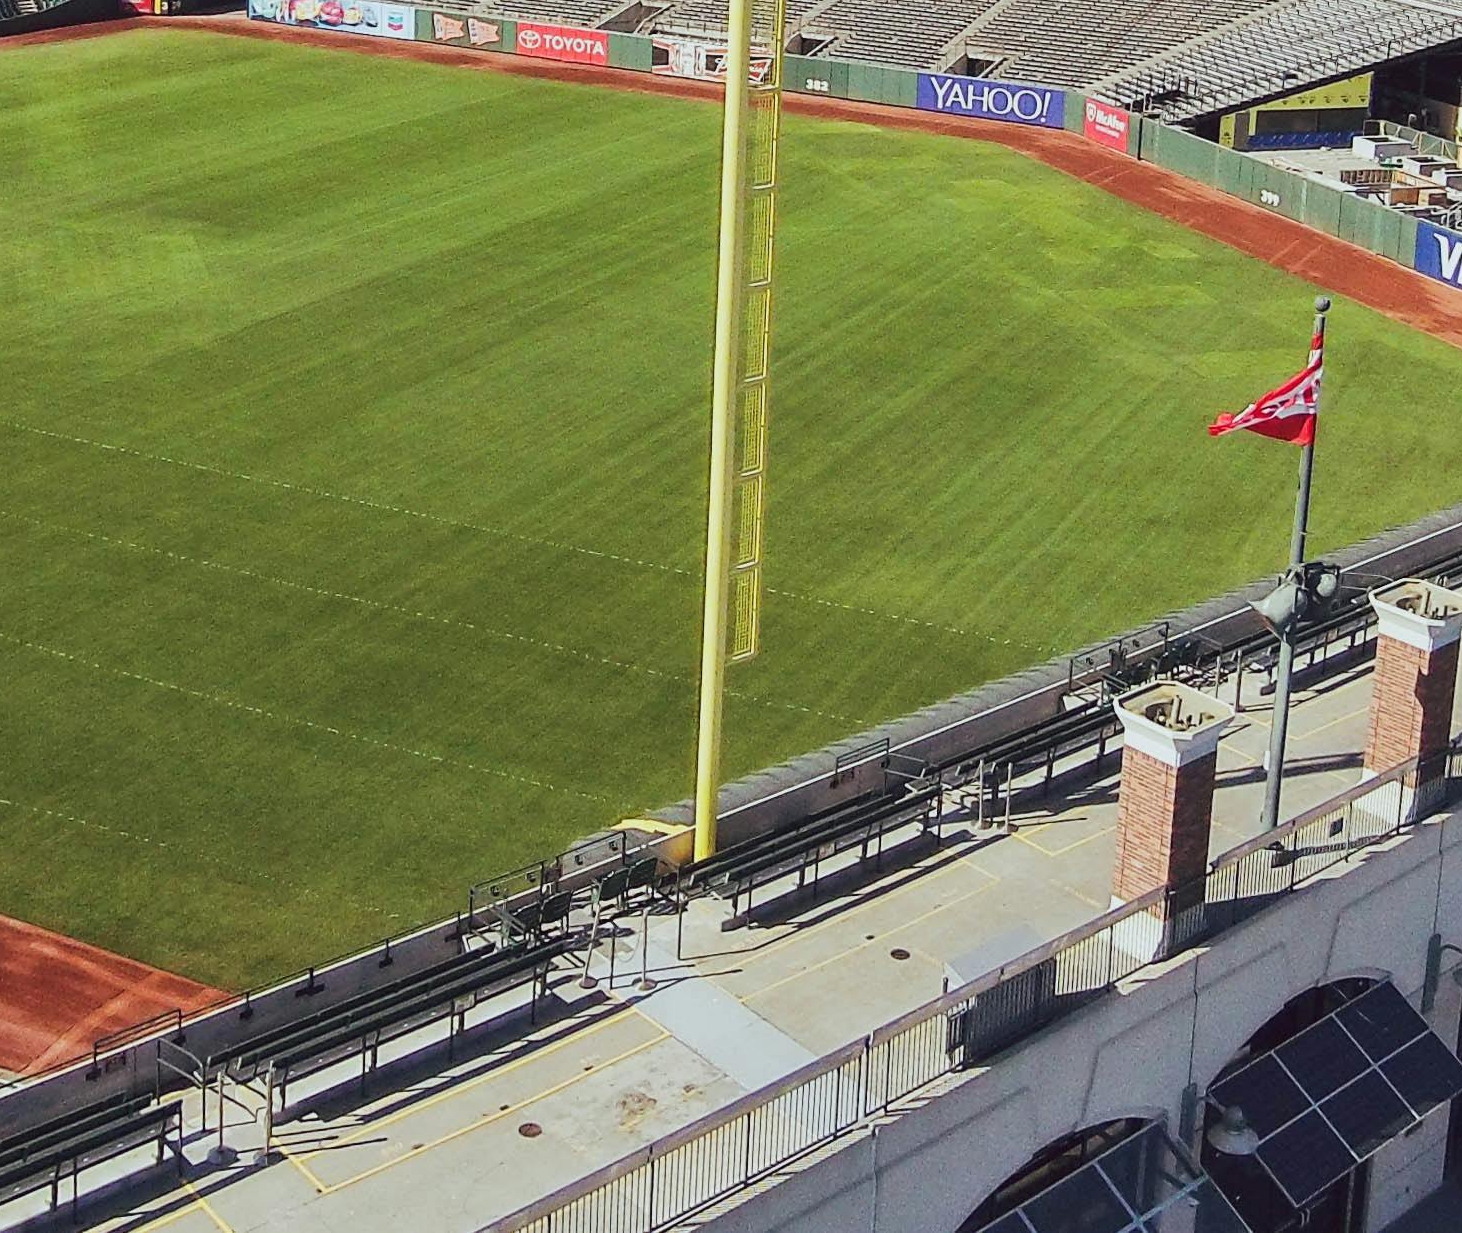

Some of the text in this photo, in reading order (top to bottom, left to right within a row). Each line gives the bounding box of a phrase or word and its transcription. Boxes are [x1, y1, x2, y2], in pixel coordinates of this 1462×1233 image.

[542, 33, 606, 56] TOYOTA
[805, 78, 830, 92] 382
[930, 75, 1052, 123] YAHOO!
[1260, 190, 1281, 207] 399
